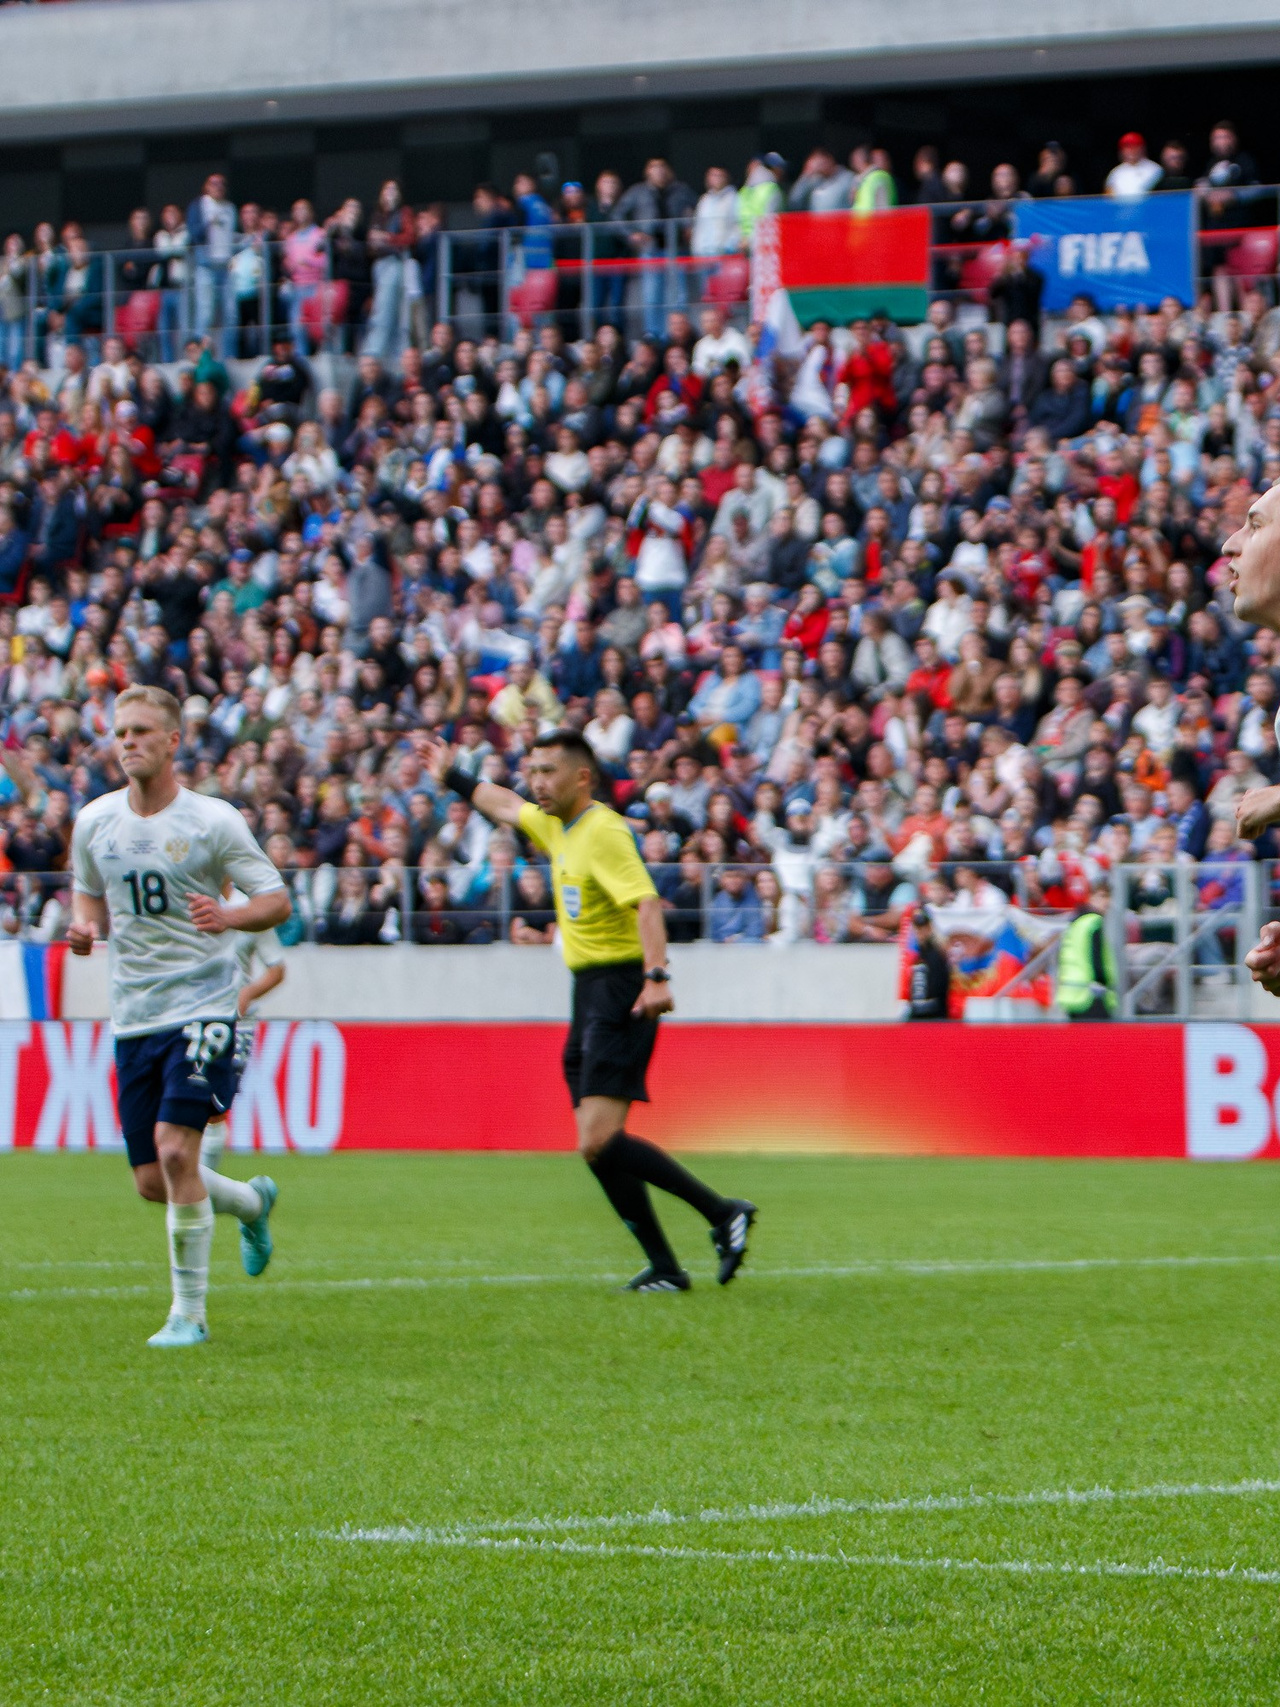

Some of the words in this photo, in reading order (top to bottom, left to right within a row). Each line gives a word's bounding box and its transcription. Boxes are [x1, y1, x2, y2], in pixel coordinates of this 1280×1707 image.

[1058, 231, 1150, 277] FIFA
[122, 869, 168, 915] 18
[33, 1020, 347, 1155] ЖКО
